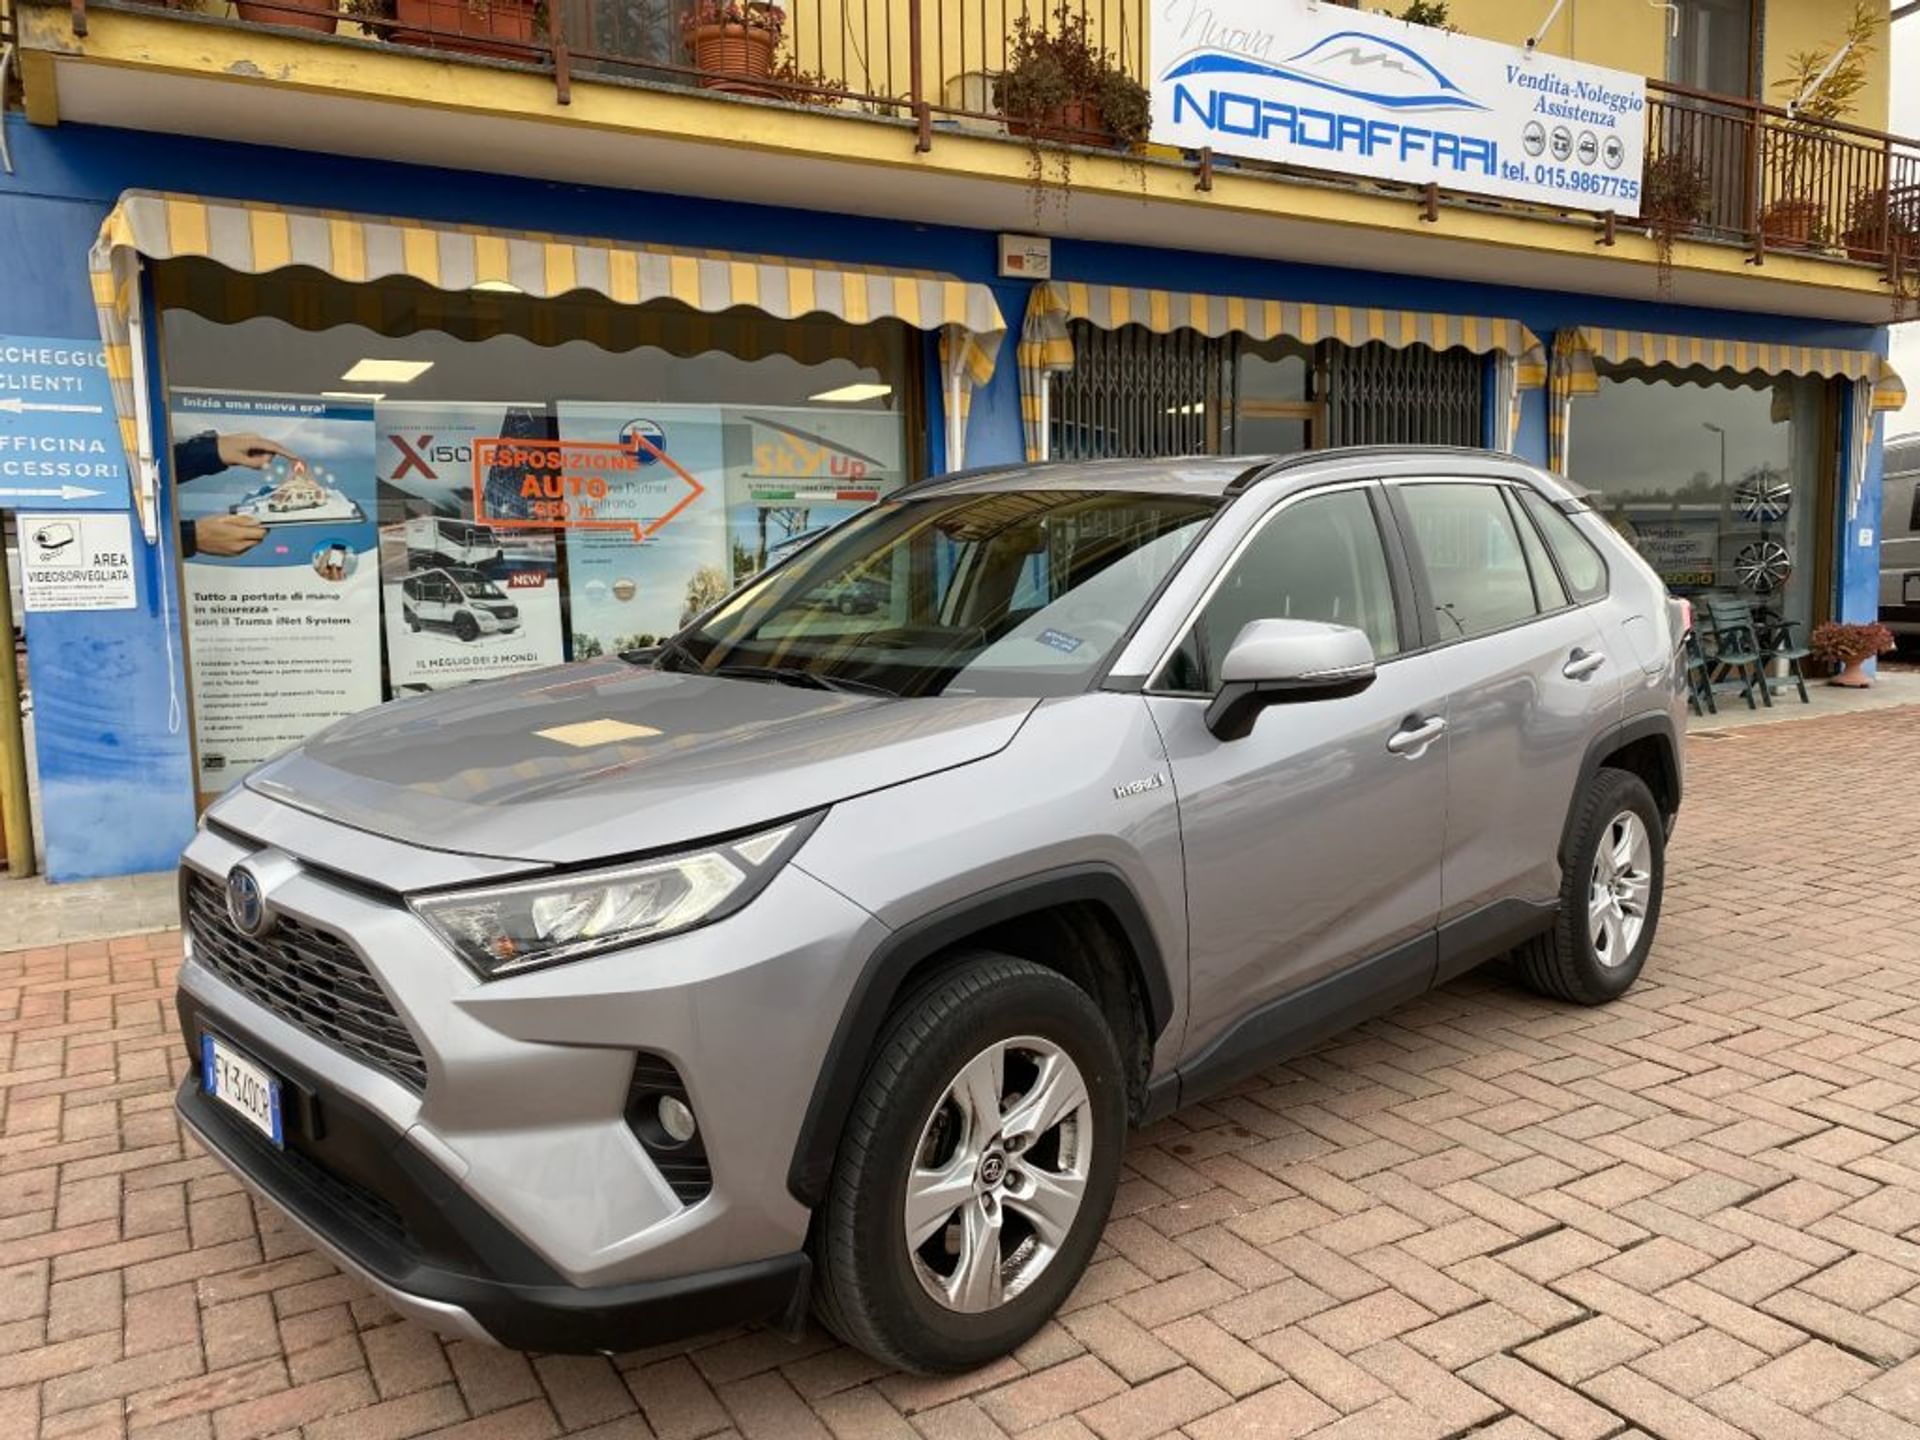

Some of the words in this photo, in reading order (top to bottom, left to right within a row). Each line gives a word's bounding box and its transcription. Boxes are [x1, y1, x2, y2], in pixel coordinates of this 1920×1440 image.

[1506, 65, 1644, 113] Vendita-Noleggio
[1533, 95, 1616, 128] Assistenza
[1173, 83, 1498, 176] NORDAFFARI
[1502, 160, 1529, 181] tel.
[1535, 164, 1639, 199] 015.9867755
[0, 346, 107, 368] CHEGGIO
[183, 397, 221, 409] Inizia
[225, 401, 251, 411] una
[255, 402, 296, 412] nuova
[300, 403, 326, 413] era!
[482, 449, 639, 472] ESPOSIZIONE
[520, 474, 609, 499] AUTO
[94, 553, 128, 567] AREA
[28, 570, 130, 583] VIDEOSORVEGLIATA
[513, 574, 542, 586] NEW
[194, 592, 226, 601] Tutto
[242, 592, 287, 603] portata
[291, 592, 303, 601] di
[194, 605, 206, 614] in
[210, 606, 269, 614] sicurezza
[195, 619, 219, 627] con
[234, 616, 273, 627] Truma
[305, 615, 351, 627] System
[429, 657, 470, 668] MEGLIO
[492, 655, 498, 664] 2
[501, 653, 537, 664] MONDI
